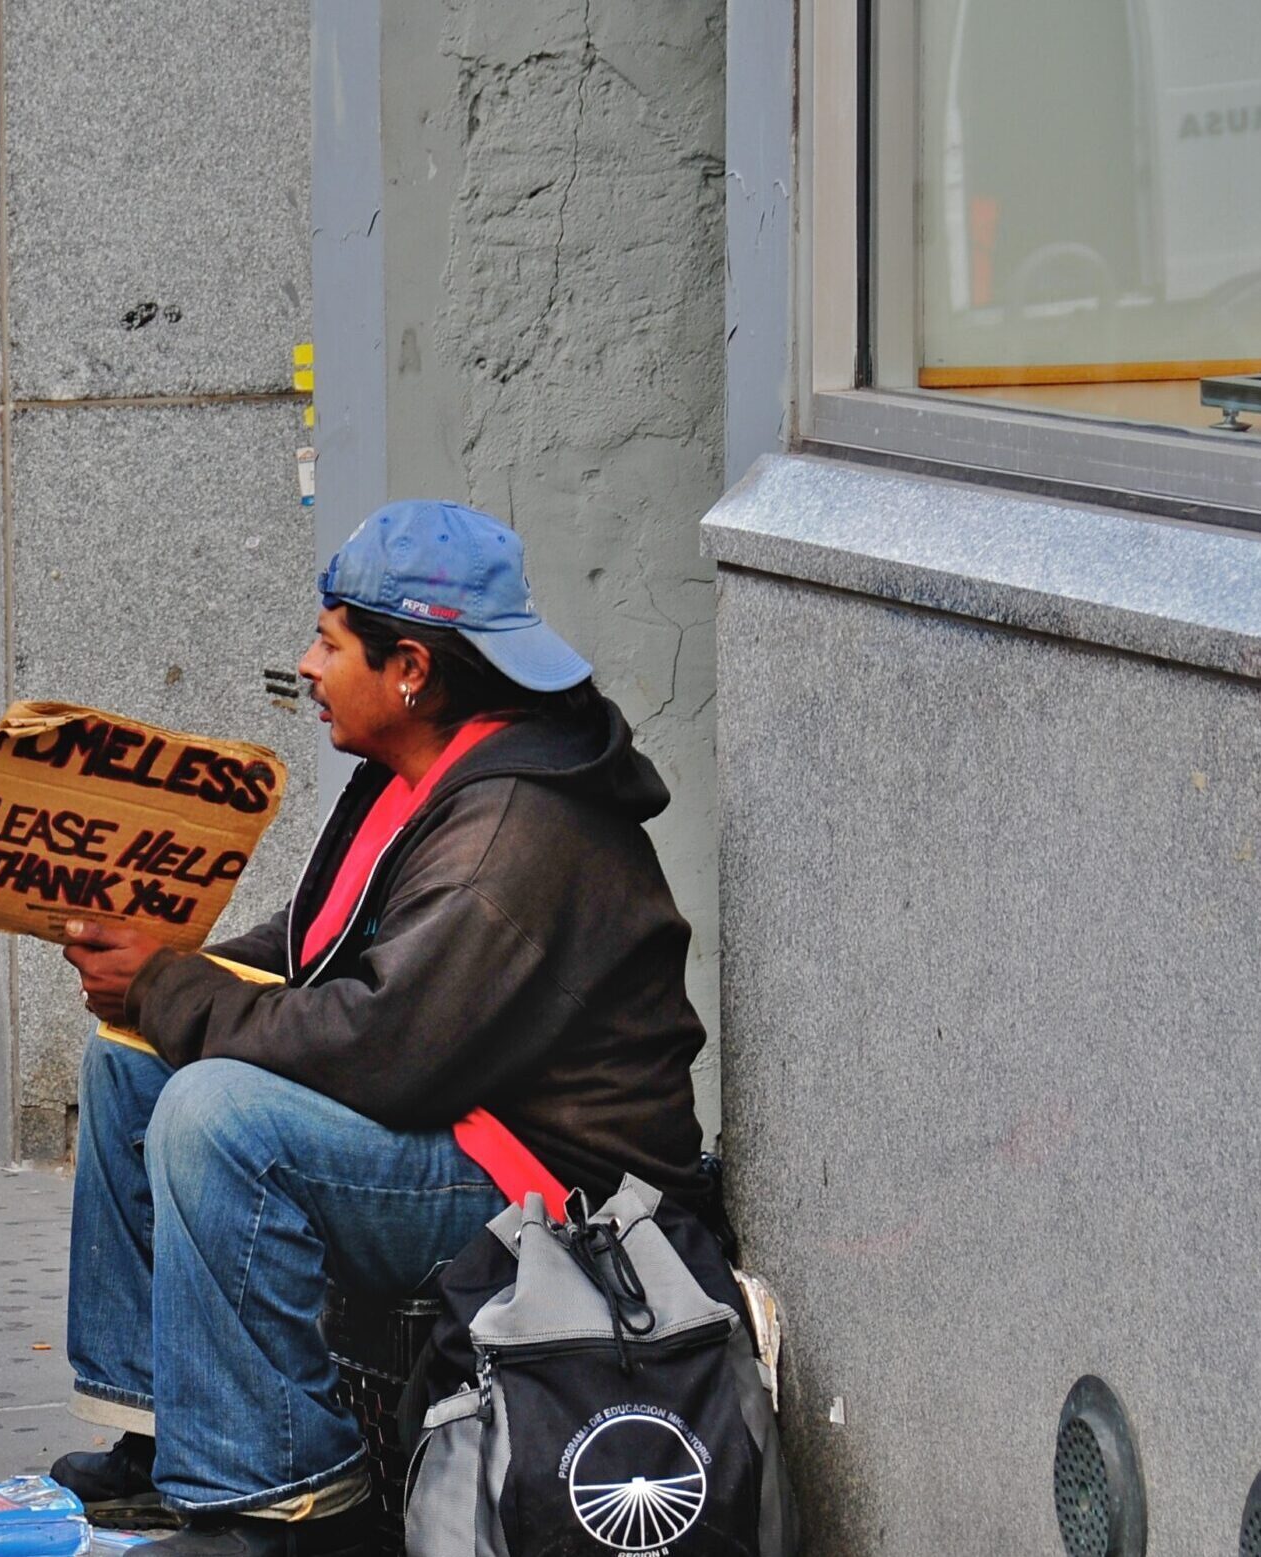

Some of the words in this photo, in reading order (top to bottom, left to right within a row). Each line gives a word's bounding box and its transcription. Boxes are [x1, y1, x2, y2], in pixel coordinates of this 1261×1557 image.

[402, 598, 430, 615] PEPSI
[115, 829, 247, 887] HELP
[558, 1425, 589, 1479] PROGRAMA
[589, 1412, 604, 1427] DE
[603, 1403, 667, 1419] EDUCACION
